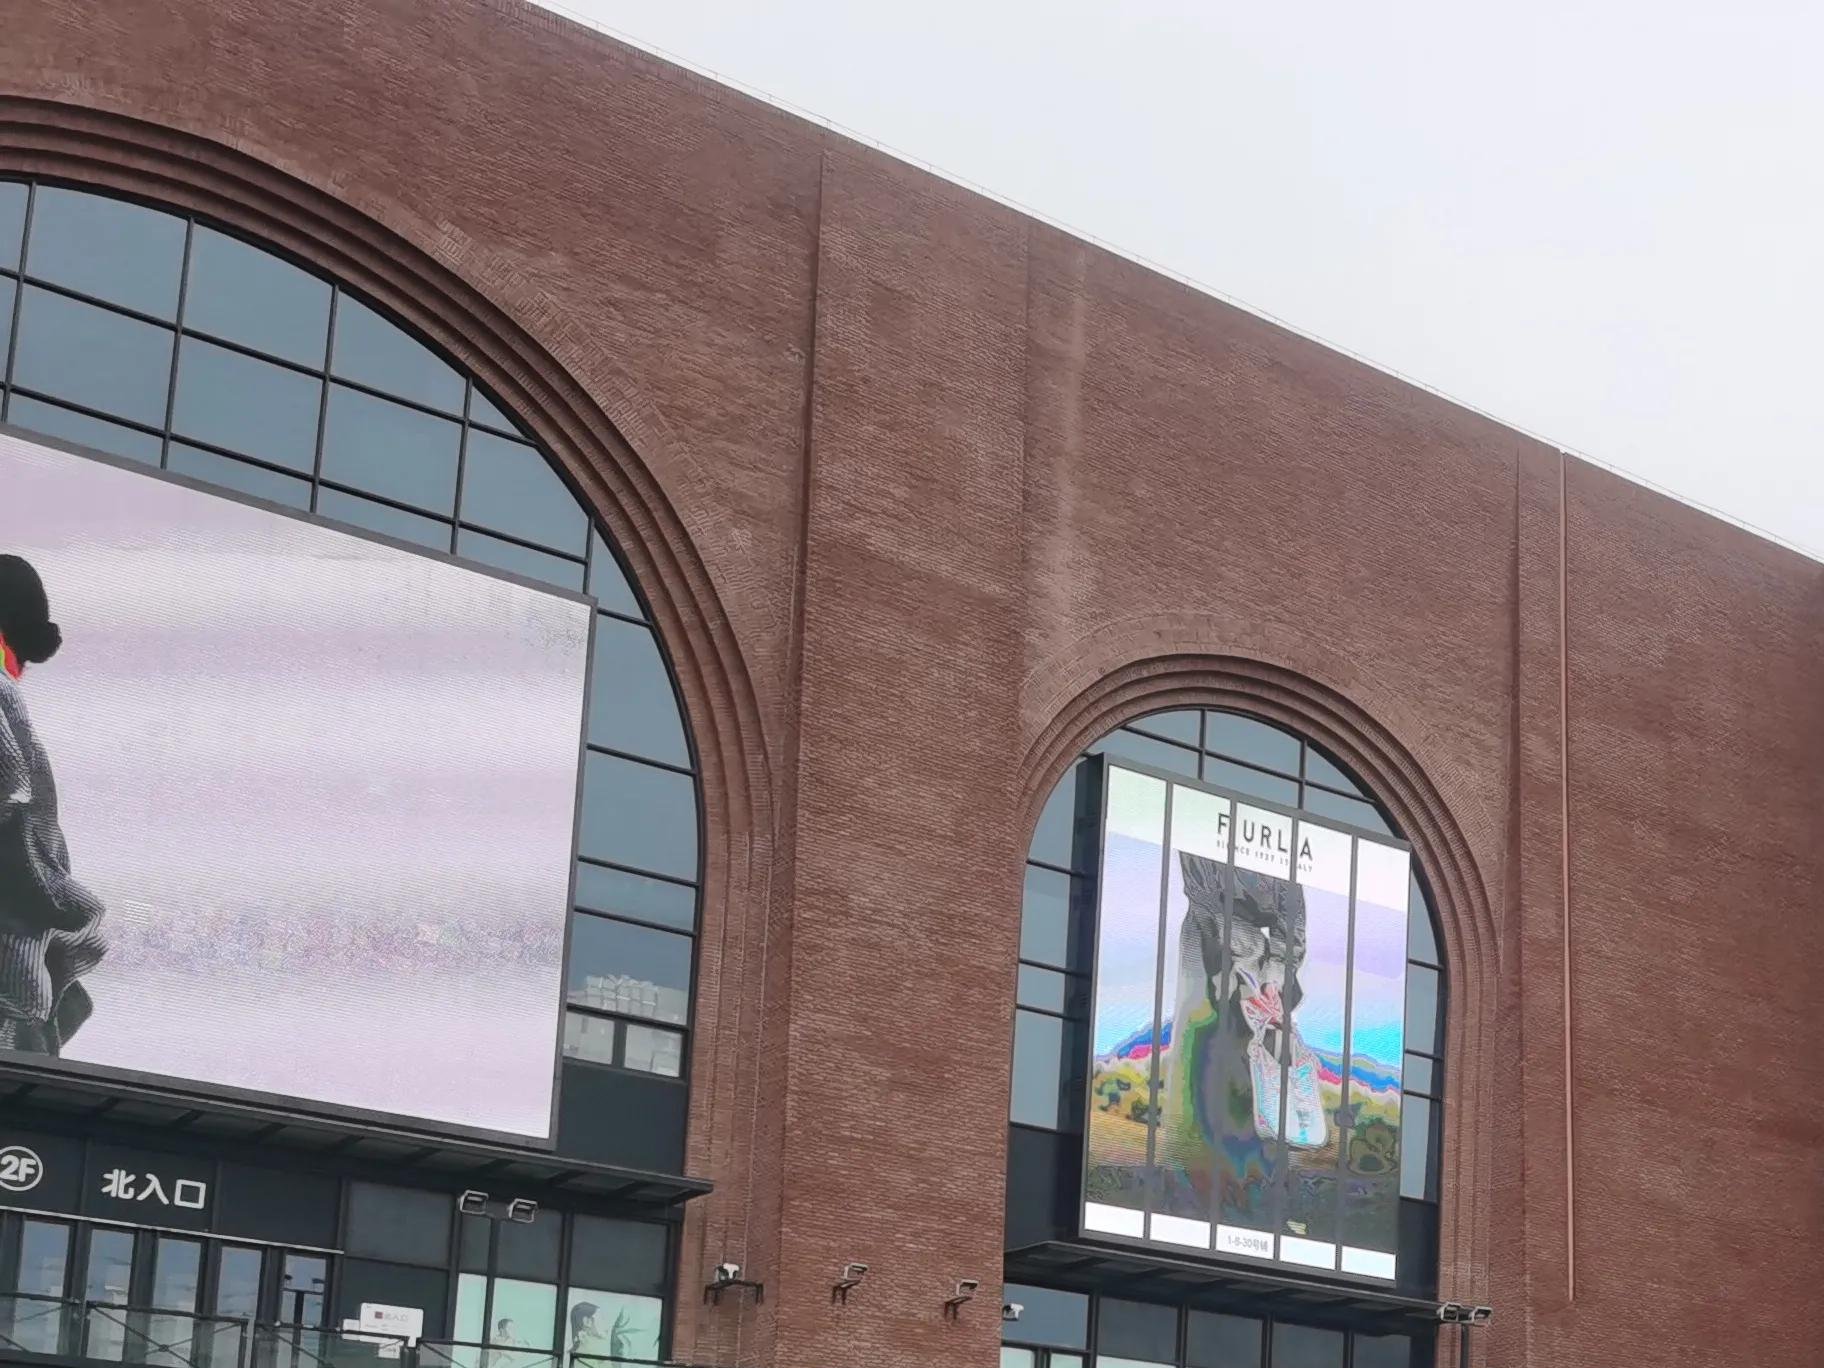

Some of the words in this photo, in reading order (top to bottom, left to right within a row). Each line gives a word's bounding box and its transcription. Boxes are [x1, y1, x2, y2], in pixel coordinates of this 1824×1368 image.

[1217, 812, 1314, 862] FURLA
[0, 1155, 37, 1183] 2F
[101, 1167, 207, 1210] 北入口
